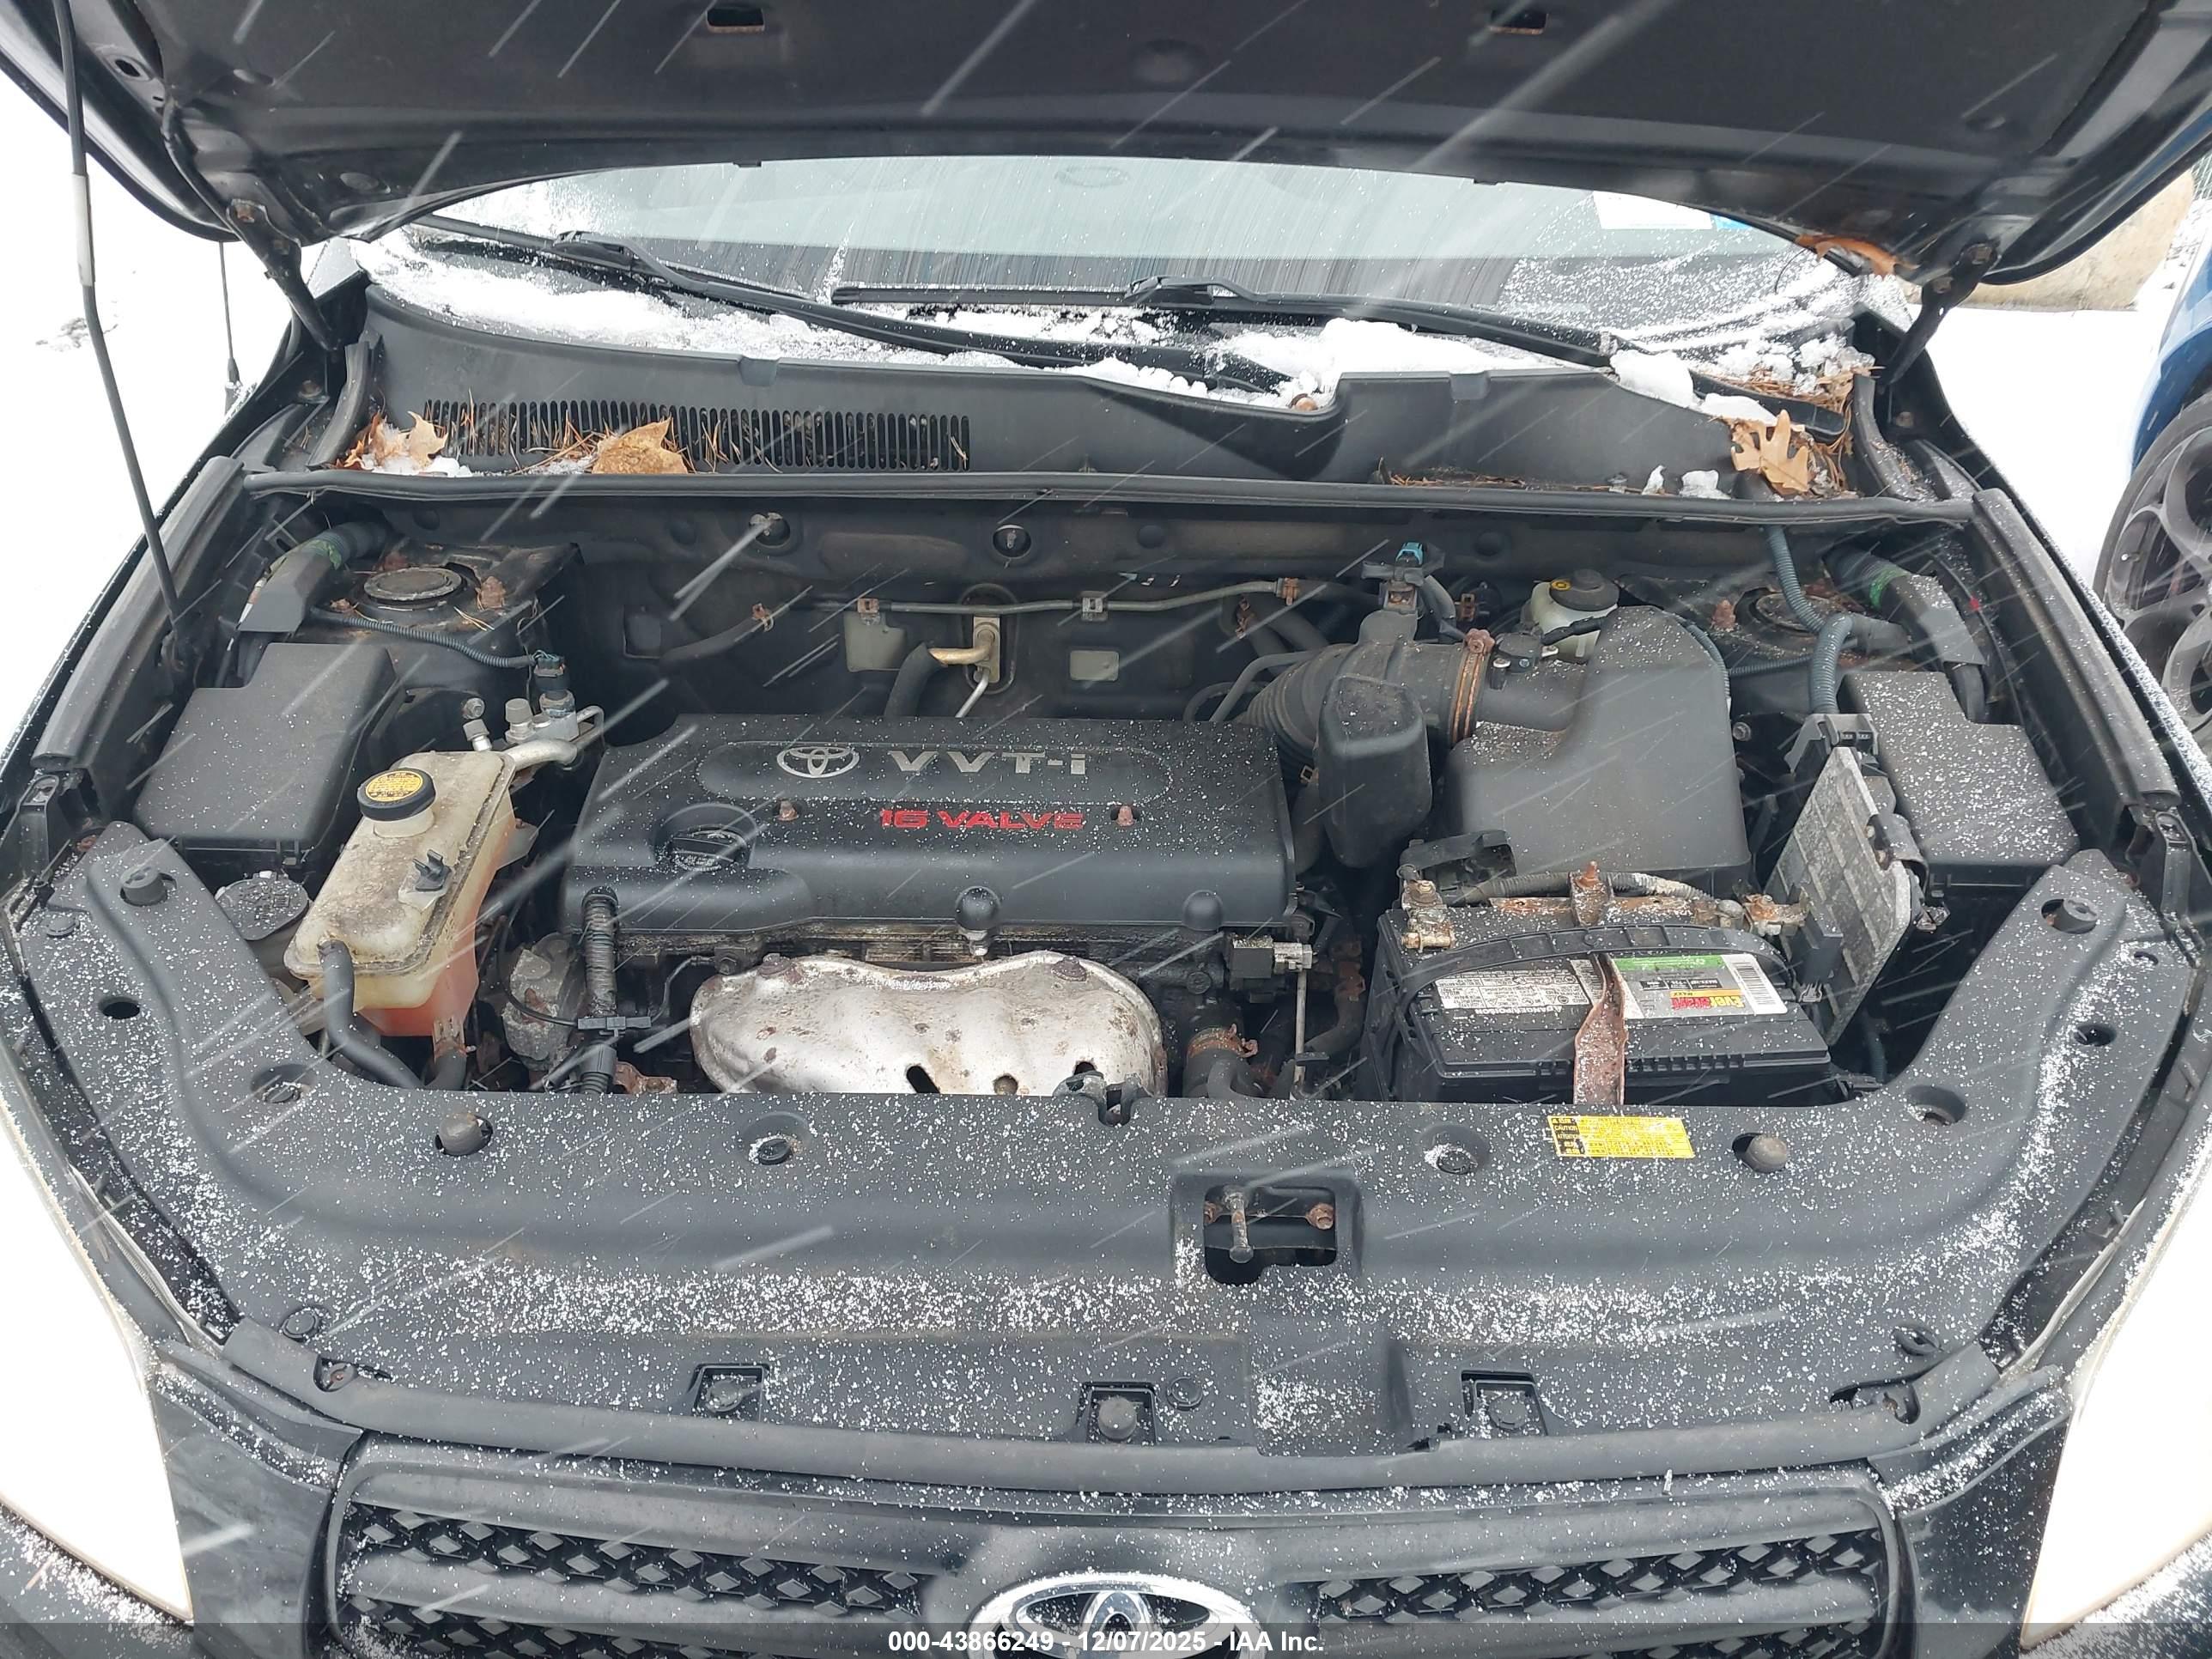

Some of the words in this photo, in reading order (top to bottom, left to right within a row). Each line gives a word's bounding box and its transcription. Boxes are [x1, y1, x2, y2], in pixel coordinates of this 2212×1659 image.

[888, 750, 1086, 775] VVT-i
[879, 809, 928, 829] 16
[937, 810, 1085, 830] VALVE
[1670, 995, 1745, 1011] EverStart
